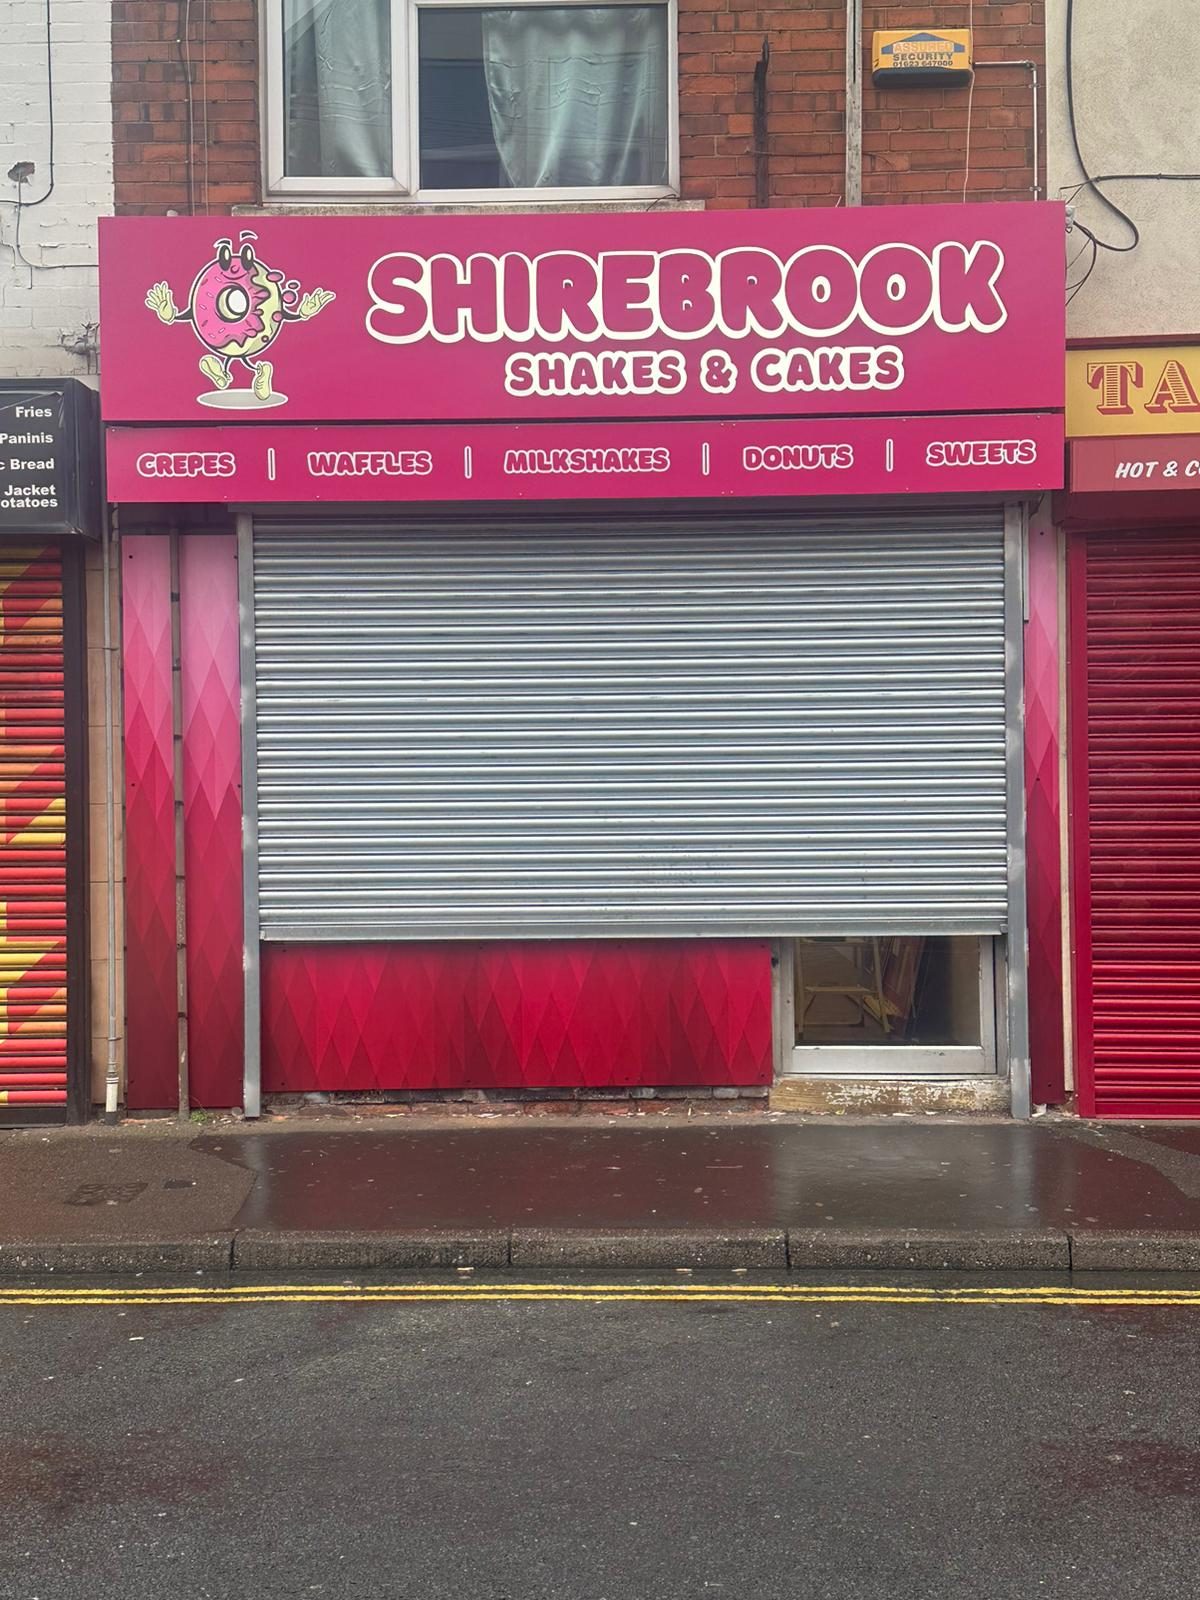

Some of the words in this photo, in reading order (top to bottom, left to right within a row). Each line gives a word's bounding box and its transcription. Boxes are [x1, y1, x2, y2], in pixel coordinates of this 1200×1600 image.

[893, 52, 953, 61] SECURITY
[366, 240, 1007, 345] SHIREBROOK
[505, 350, 687, 397] SHAKES
[700, 349, 738, 394] &
[751, 345, 905, 393] CAKES
[1087, 360, 1200, 415] TA
[15, 406, 52, 418] Fries
[0, 432, 54, 444] Paninis
[10, 458, 55, 470] Bread
[136, 451, 236, 478] CREPES
[307, 450, 433, 477] WAFFLES
[503, 447, 671, 475] MILKSHAKES
[742, 443, 854, 471] DONUTS
[925, 439, 1037, 467] SWEETS
[1115, 462, 1159, 478] HOT
[1162, 460, 1178, 477] &
[1184, 460, 1200, 477] C
[0, 497, 58, 508] otatoes
[4, 484, 56, 496] Jacket
